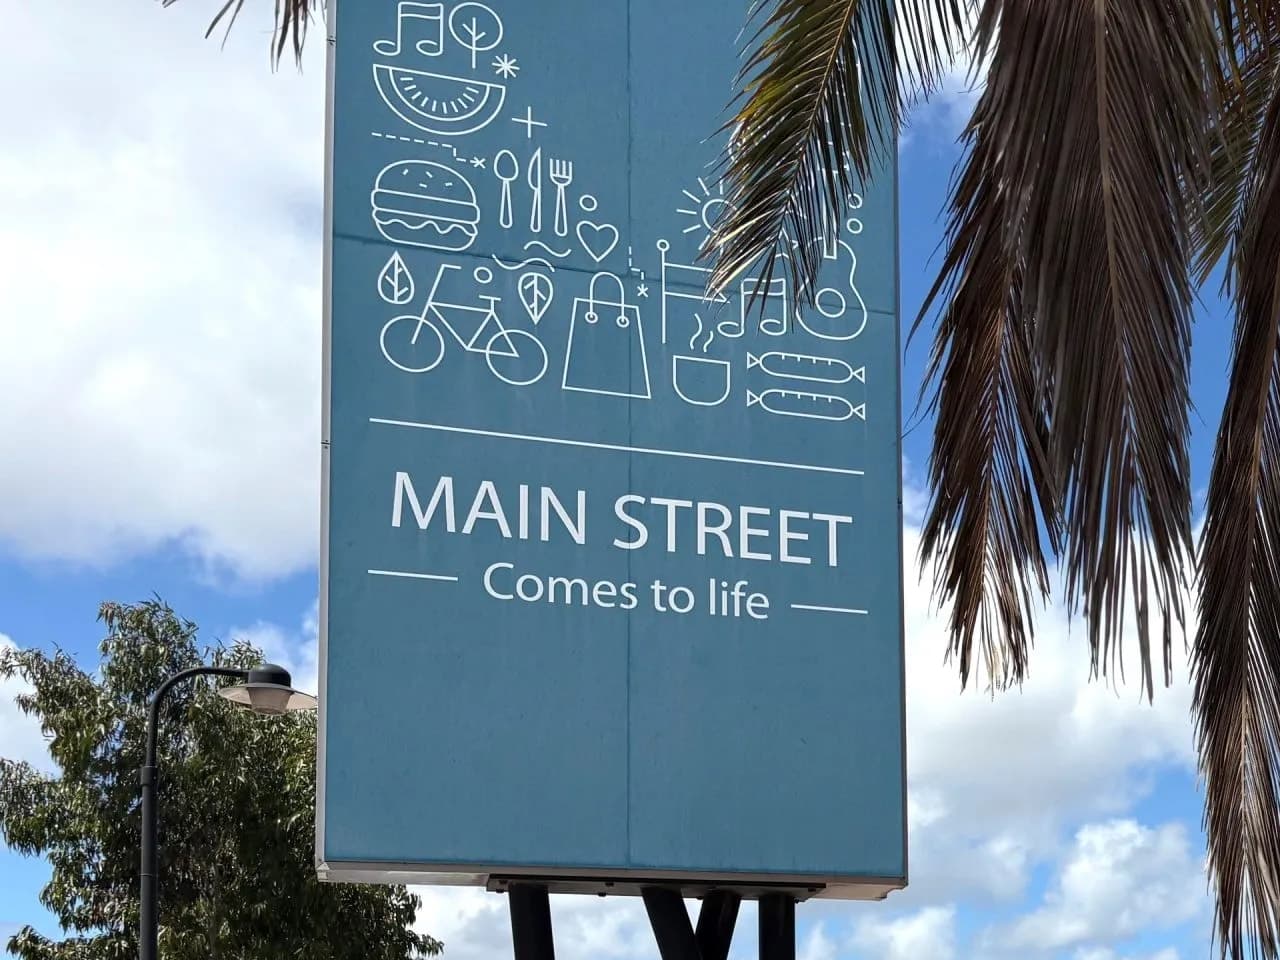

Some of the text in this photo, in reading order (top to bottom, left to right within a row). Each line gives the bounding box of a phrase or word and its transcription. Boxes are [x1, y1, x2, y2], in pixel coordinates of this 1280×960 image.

[390, 471, 853, 567] MAIN STREET
[483, 562, 770, 619] Comes to life
